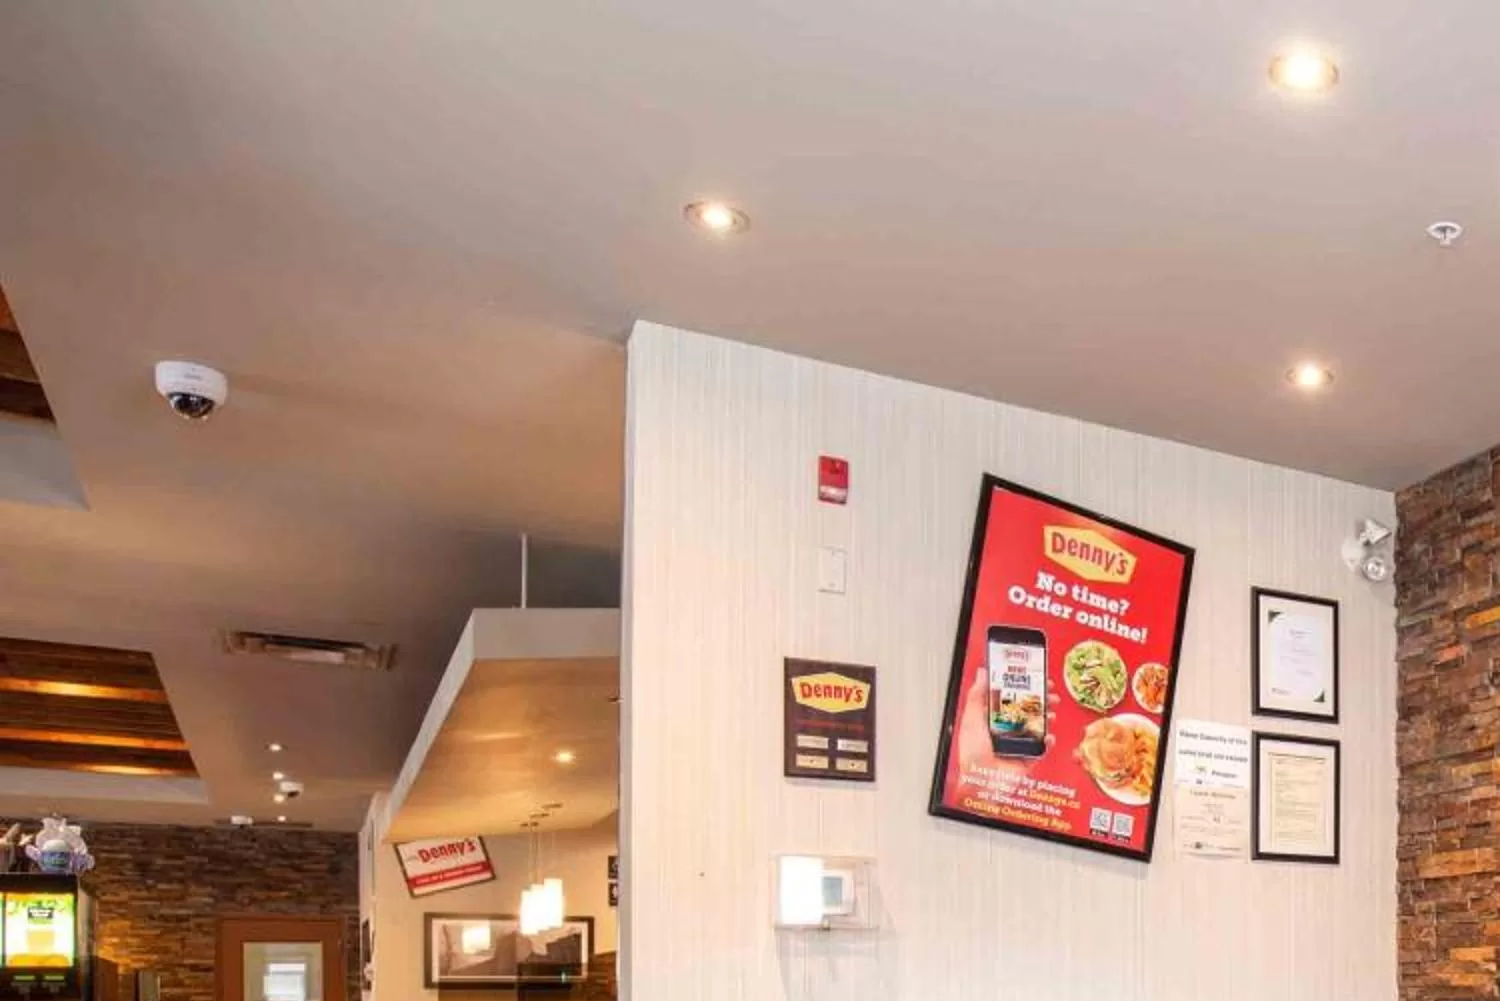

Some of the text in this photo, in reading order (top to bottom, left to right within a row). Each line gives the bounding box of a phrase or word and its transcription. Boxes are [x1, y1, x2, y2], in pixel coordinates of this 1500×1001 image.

[1051, 531, 1129, 577] Denny's
[1008, 585, 1149, 645] Order online!
[1036, 570, 1131, 617] No time?
[800, 681, 865, 704] Denny's
[418, 838, 477, 863] Denny's
